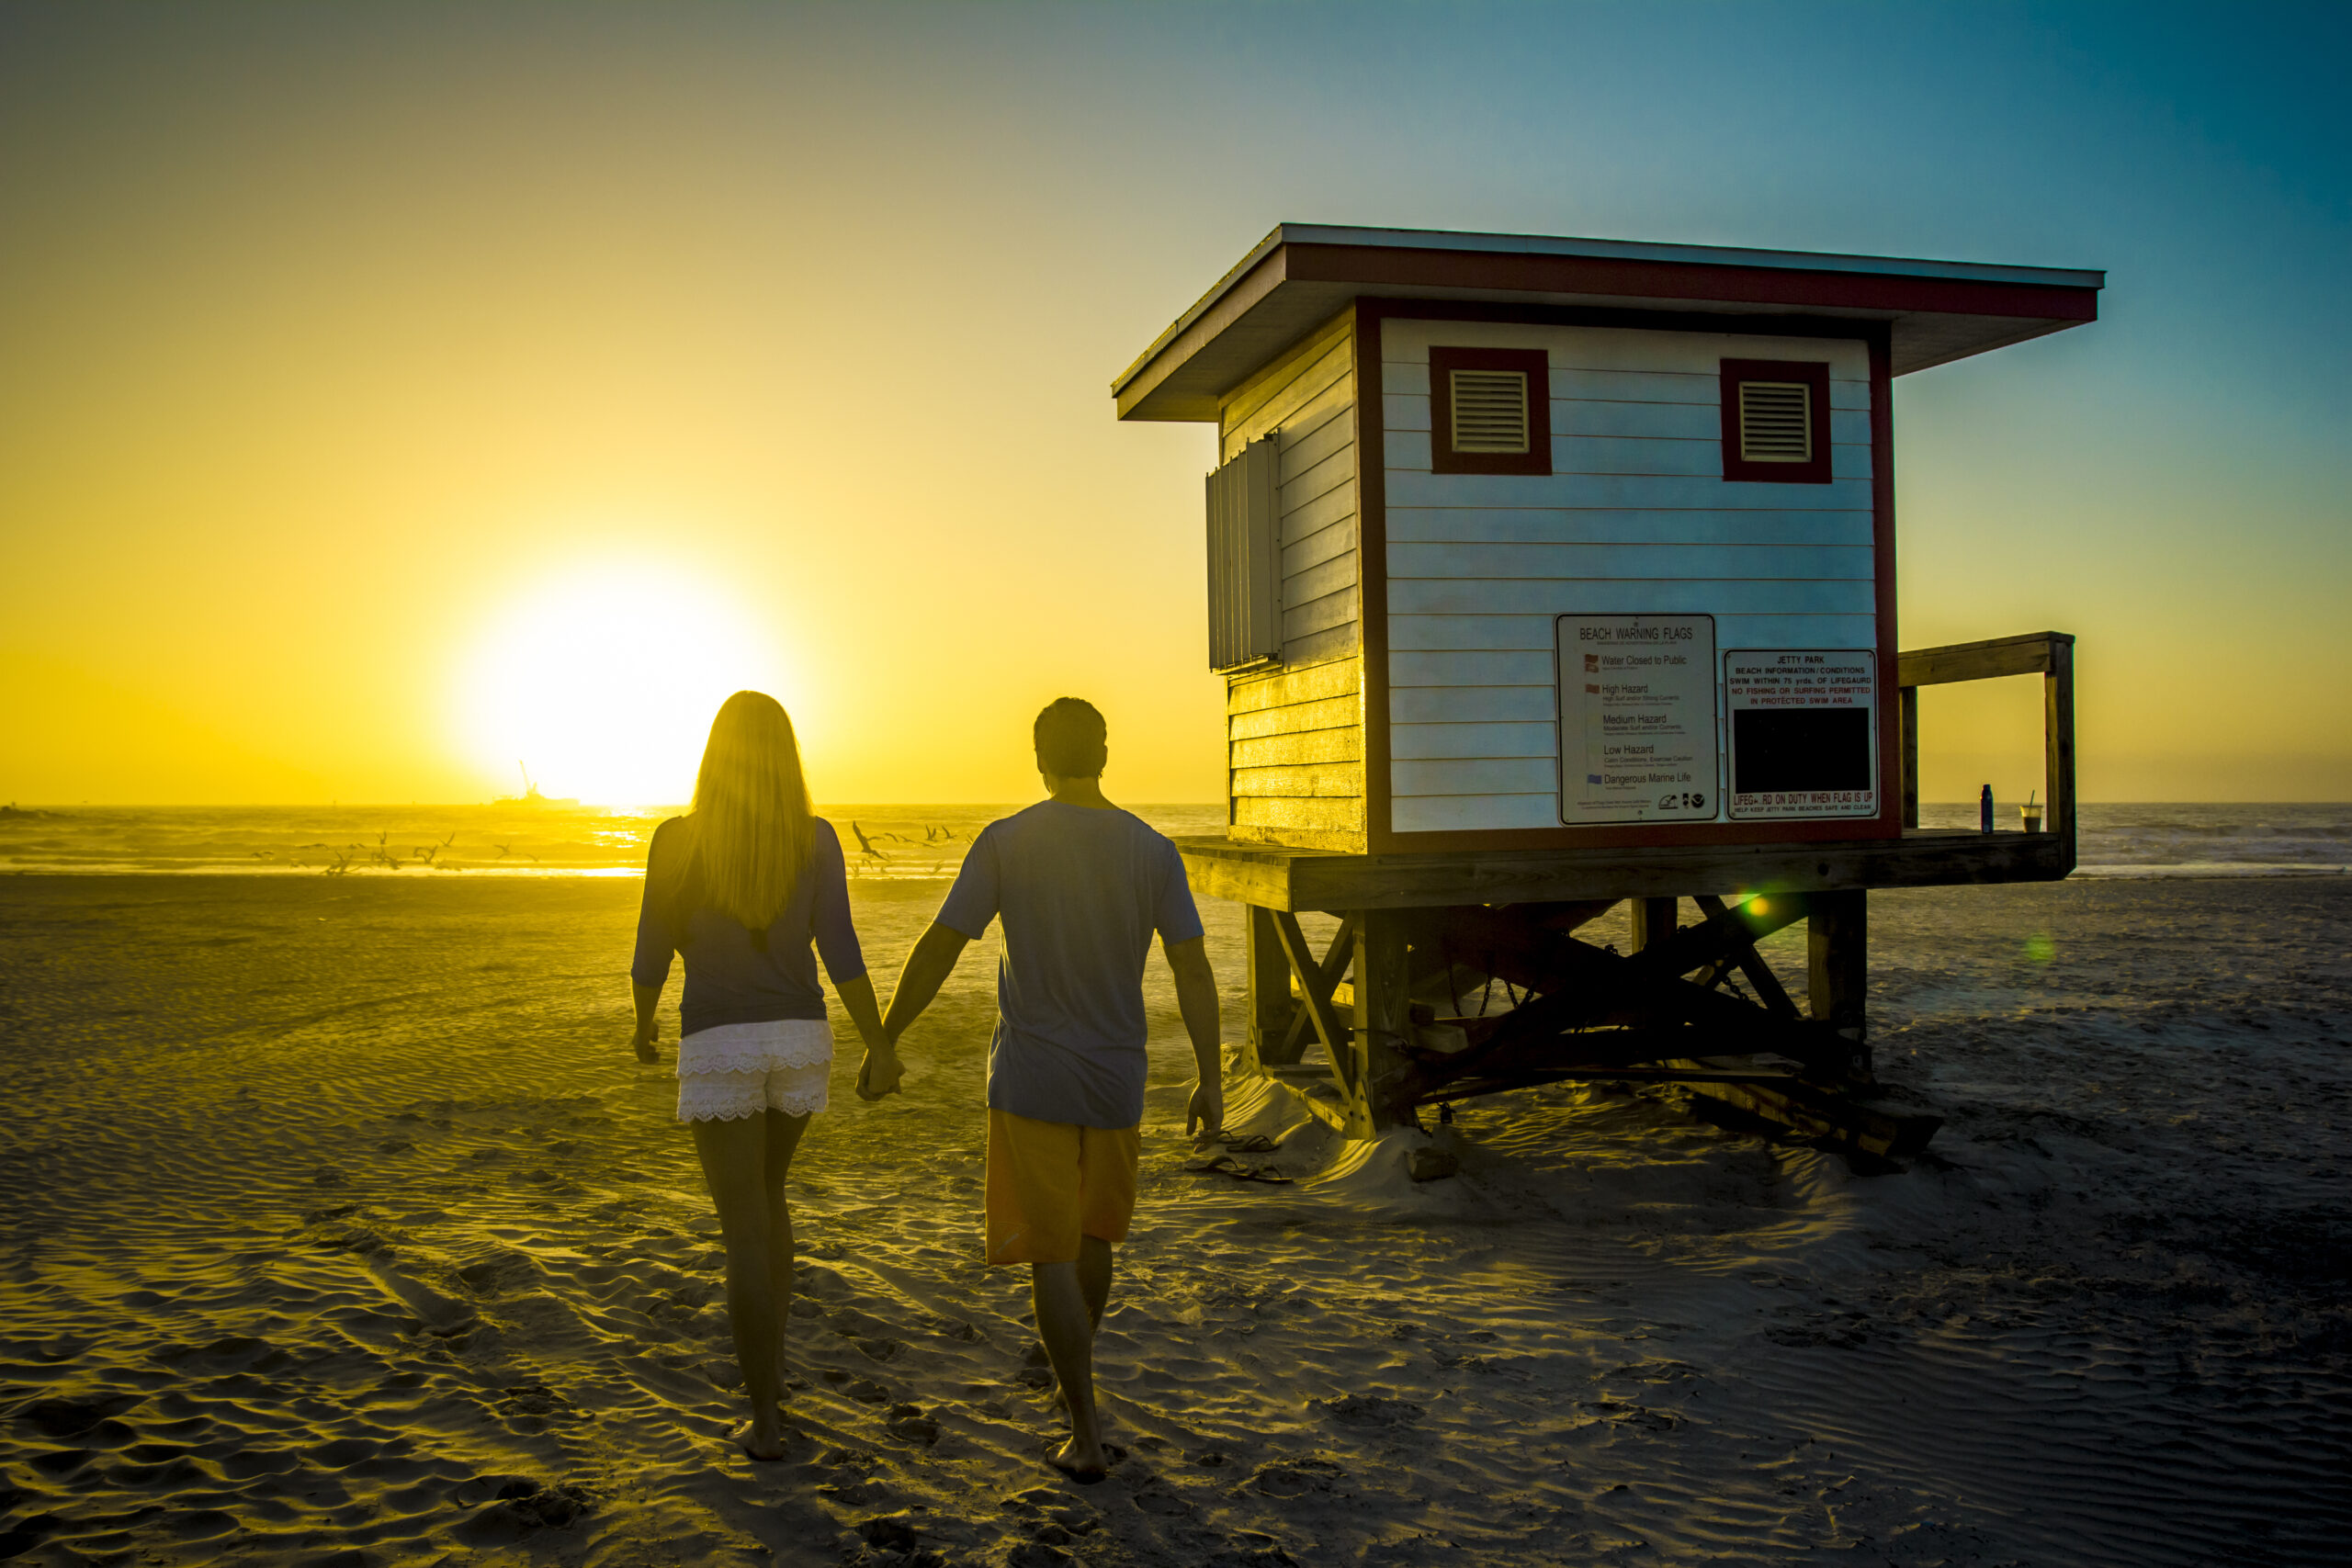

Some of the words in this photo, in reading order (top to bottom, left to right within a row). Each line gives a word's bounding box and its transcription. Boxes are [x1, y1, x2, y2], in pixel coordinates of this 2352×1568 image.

[1580, 628, 1611, 639] BEACH
[1616, 627, 1658, 639] WARNING
[1664, 627, 1692, 639] FLAGS
[1601, 656, 1624, 665] Water
[1626, 656, 1652, 665] Closed
[1654, 656, 1661, 665] to
[1664, 656, 1687, 665] Public
[1778, 656, 1801, 664] JETTY
[1805, 656, 1825, 664] PARK
[1602, 684, 1619, 695] High
[1623, 684, 1648, 693] Hazard
[1603, 715, 1635, 724] Medium
[1638, 715, 1667, 724] Hazard
[1604, 745, 1621, 754] Low
[1624, 745, 1654, 754] Hazard
[1605, 774, 1646, 785] Dangerous
[1649, 773, 1674, 783] Marine
[1678, 773, 1690, 782] Life
[1734, 794, 1771, 806] LIFEGRD
[1776, 794, 1786, 805] ON
[1789, 794, 1807, 804] DUTY
[1811, 793, 1830, 804] WHEN
[1834, 793, 1851, 803] FLAG
[1855, 792, 1860, 803] IS
[1864, 792, 1872, 802] UP
